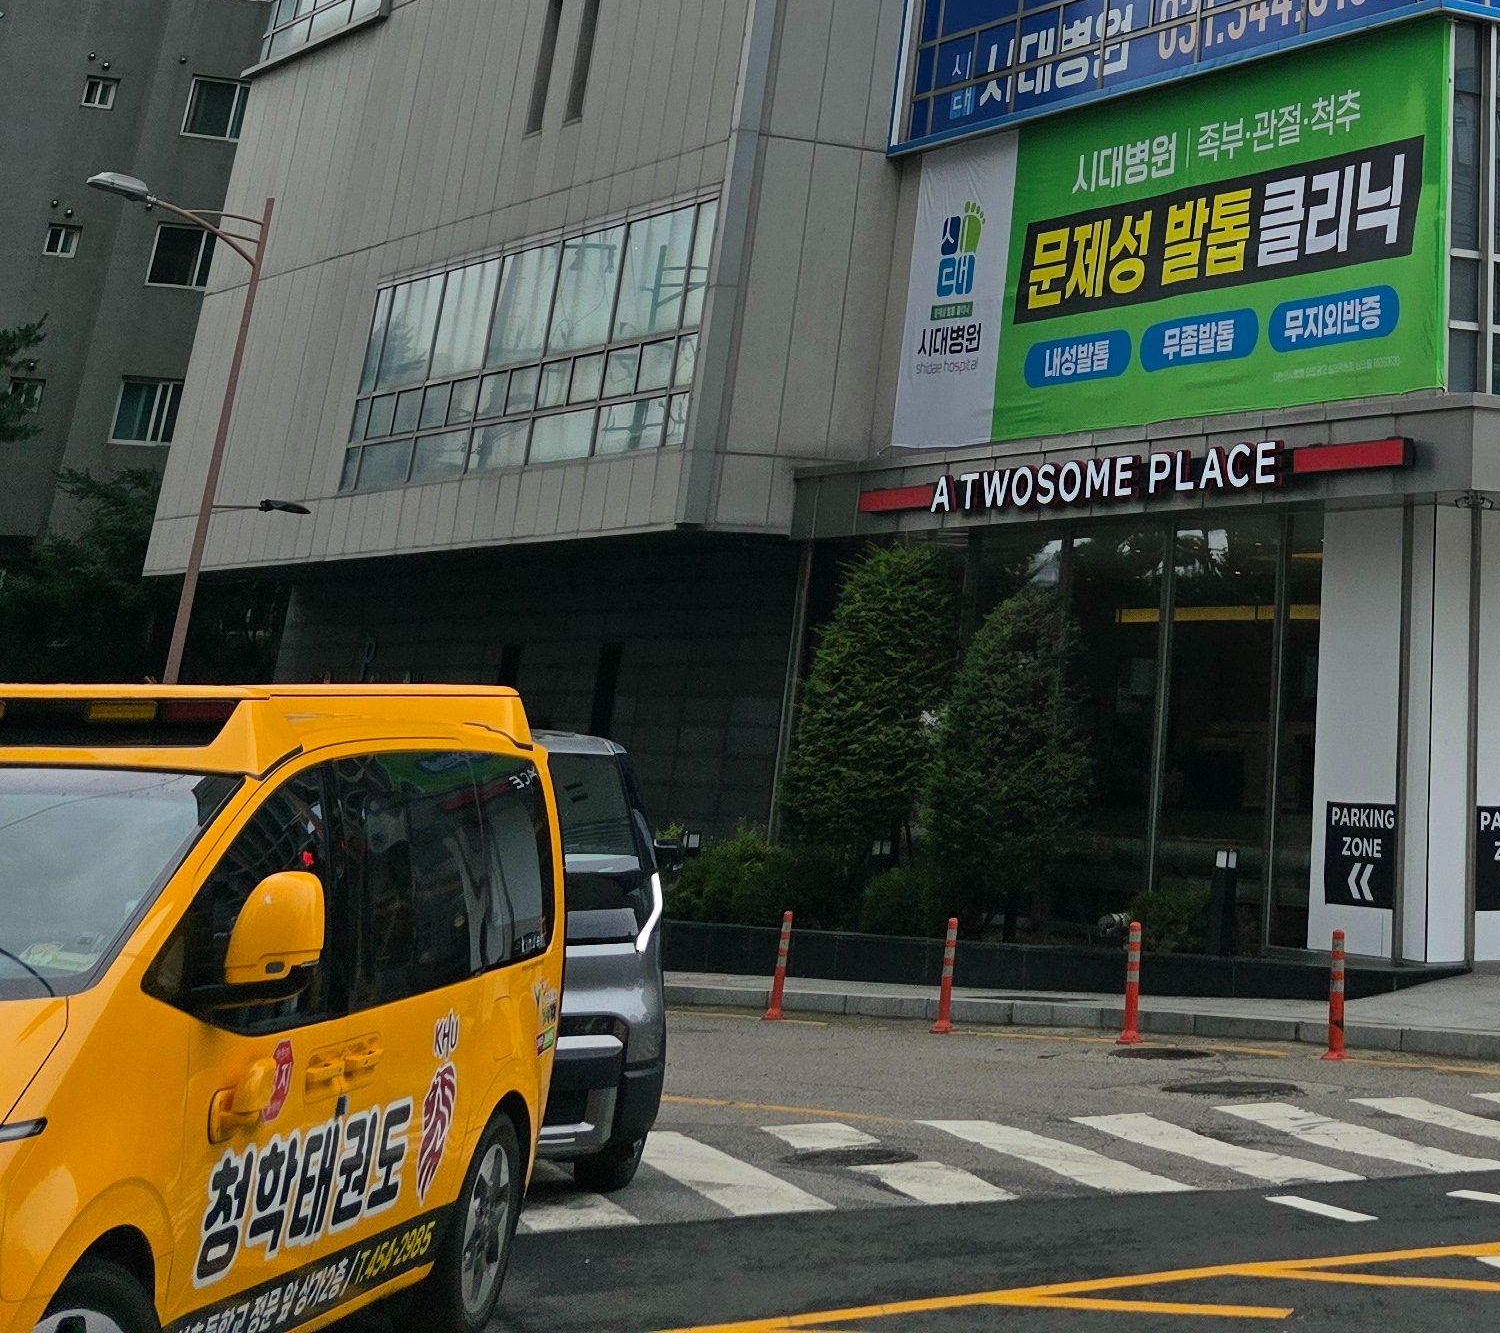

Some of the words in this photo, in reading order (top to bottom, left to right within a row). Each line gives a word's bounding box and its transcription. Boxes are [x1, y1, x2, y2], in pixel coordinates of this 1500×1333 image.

[979, 3, 1134, 108] 시대병원
[1072, 132, 1177, 194] 시대병원
[1026, 210, 1153, 311] 문제성
[1160, 187, 1254, 287] 발톱
[1257, 152, 1405, 268] 클리닉
[916, 362, 943, 375] shidae
[943, 357, 979, 375] hospital
[917, 322, 982, 358] 시대병원
[1044, 340, 1111, 378] 내성발톱
[1162, 319, 1235, 360] 무좀발톱
[1283, 294, 1382, 342] 무지외반증
[931, 475, 951, 513] A
[961, 455, 1135, 509] TWOSOME
[1148, 441, 1278, 494] PLACE
[1331, 807, 1395, 830] PARKING
[1341, 836, 1383, 859] ZONE
[434, 1015, 460, 1057] KHU
[194, 1097, 412, 1287] 청학태권도
[355, 1221, 436, 1284] T.454-2985
